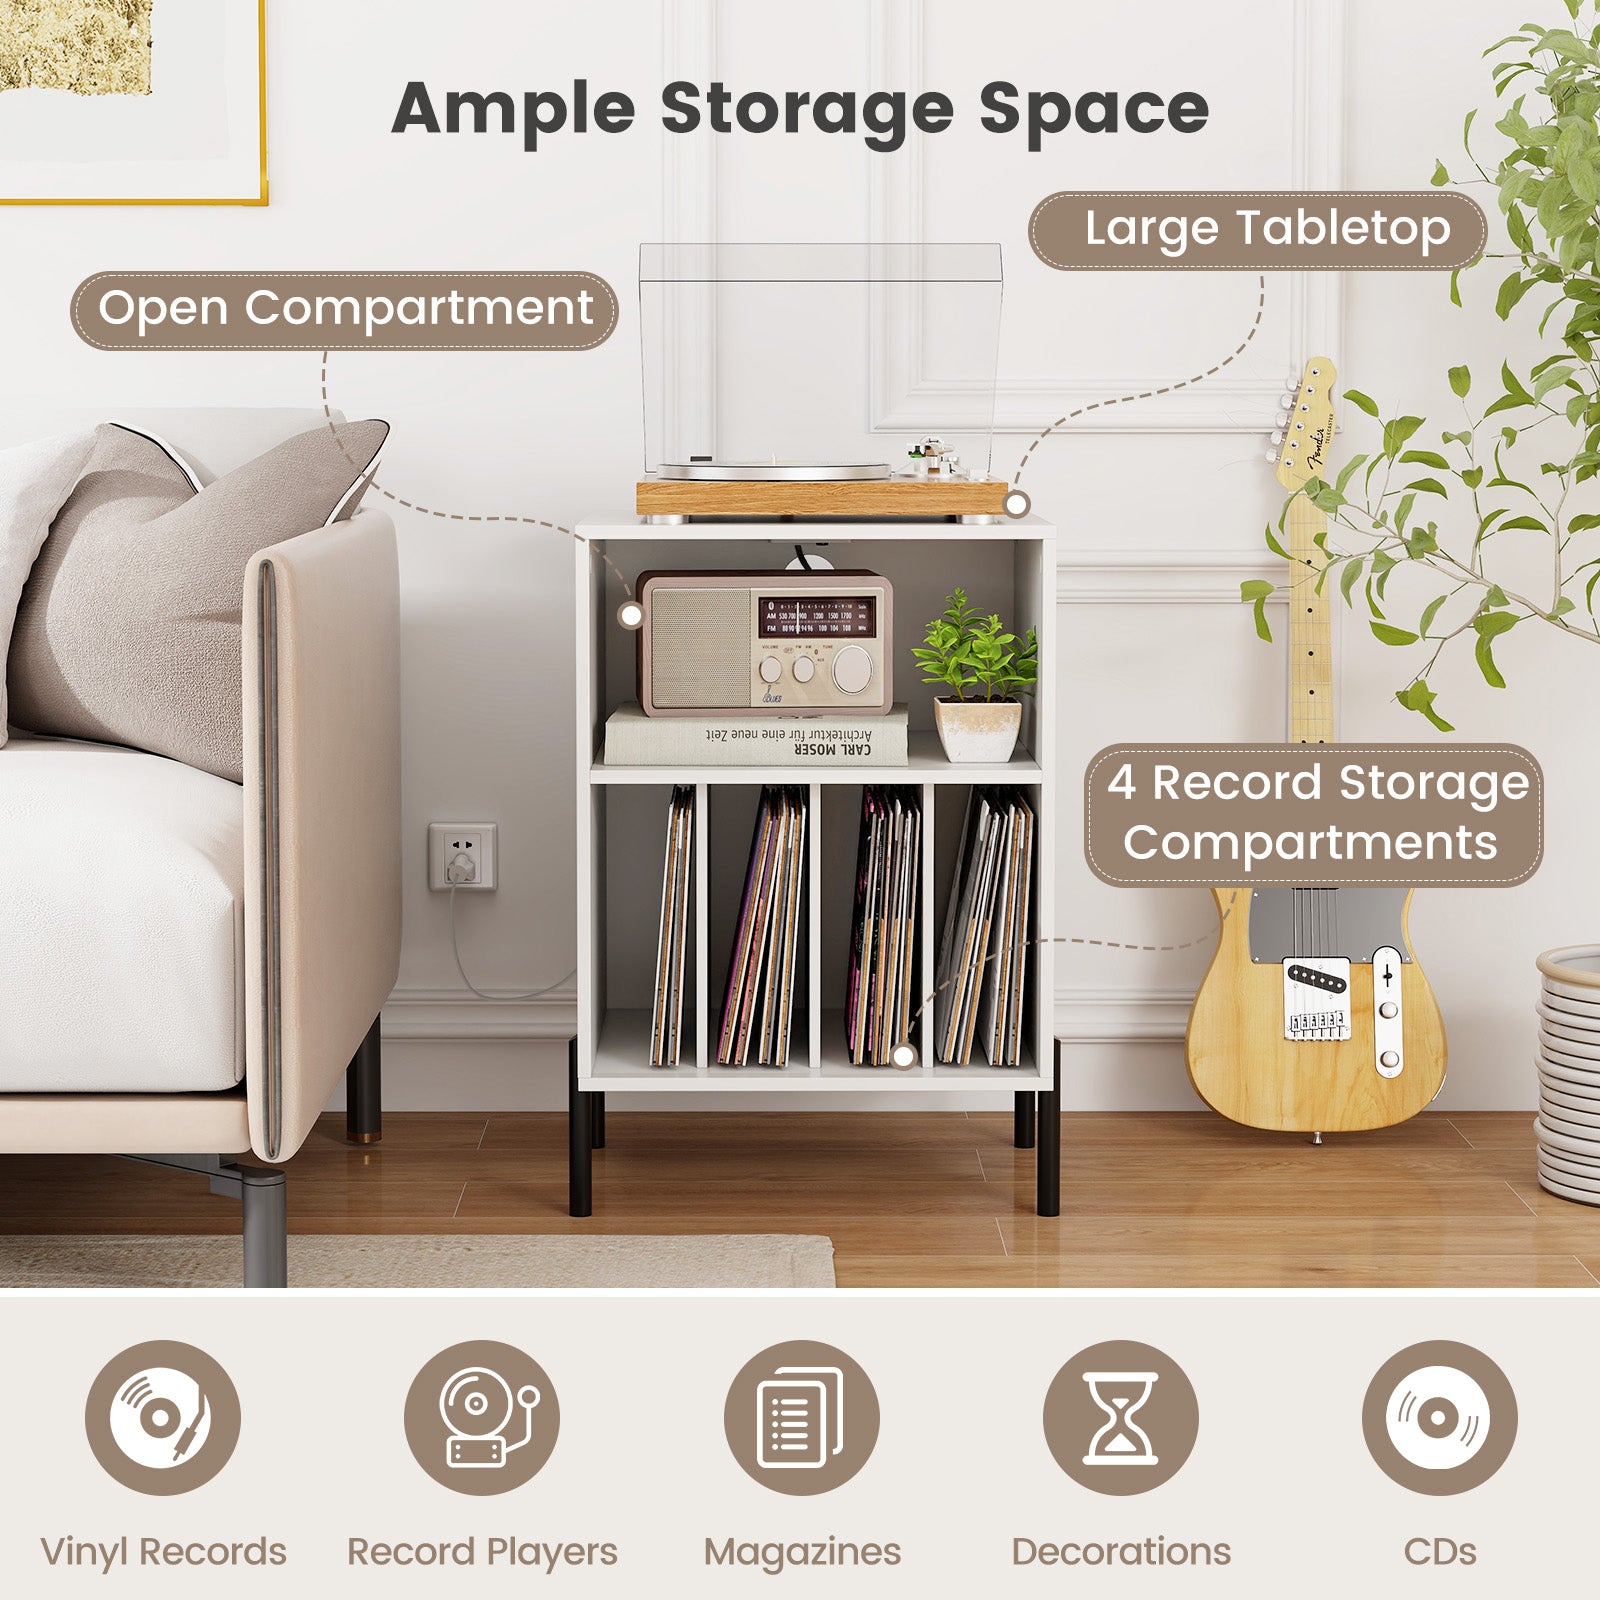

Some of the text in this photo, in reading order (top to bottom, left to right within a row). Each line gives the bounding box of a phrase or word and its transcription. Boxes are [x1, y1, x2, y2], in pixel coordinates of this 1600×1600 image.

[706, 729, 872, 742] Architektur für eine neue Zeit
[795, 743, 871, 755] CARL MOSER
